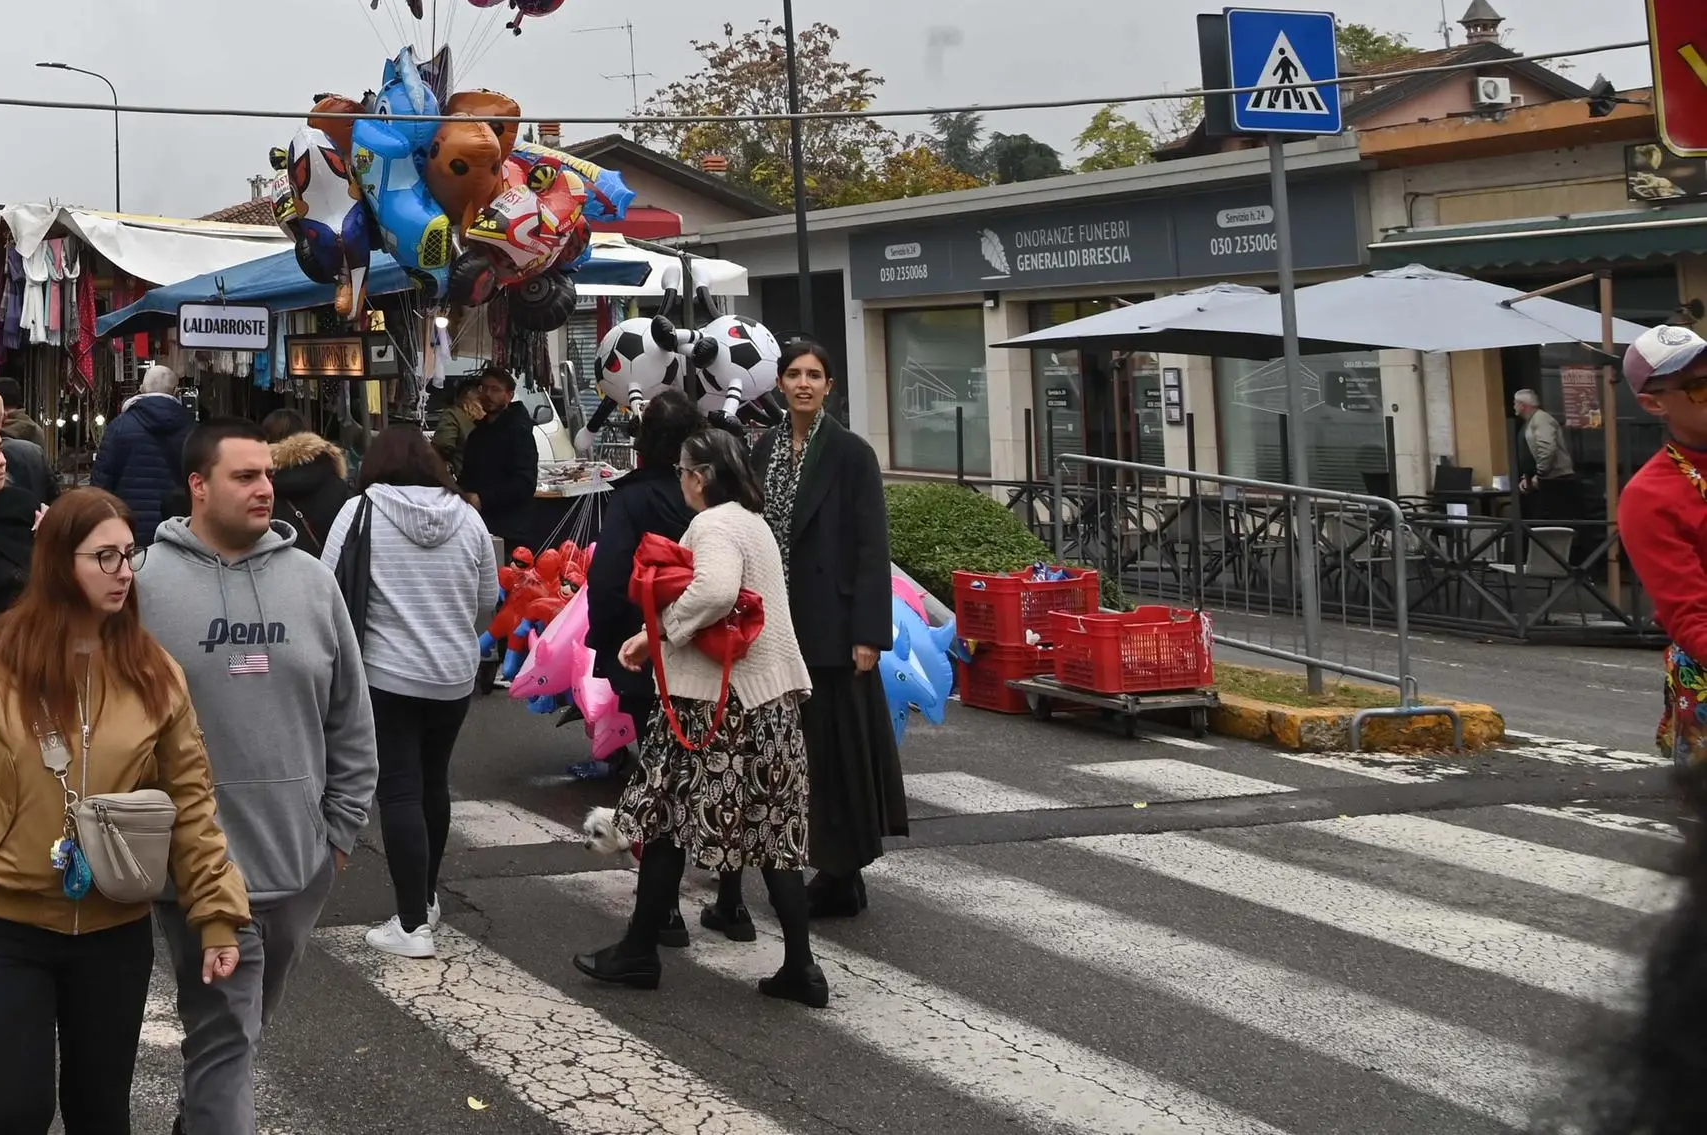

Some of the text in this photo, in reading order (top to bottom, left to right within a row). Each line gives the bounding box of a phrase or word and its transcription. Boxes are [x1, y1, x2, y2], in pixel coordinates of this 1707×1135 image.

[1225, 212, 1250, 224] Servizio
[1256, 209, 1266, 220] 24
[1015, 220, 1130, 248] ONORANZE FUNEBRI
[1210, 233, 1278, 256] 030 235006
[1016, 245, 1132, 271] GENERALI DI BRESCIA
[880, 264, 928, 282] 030 2350068
[182, 317, 266, 336] CALDARROSTE
[301, 344, 350, 368] CALDARROSTE
[198, 617, 286, 653] Penn
